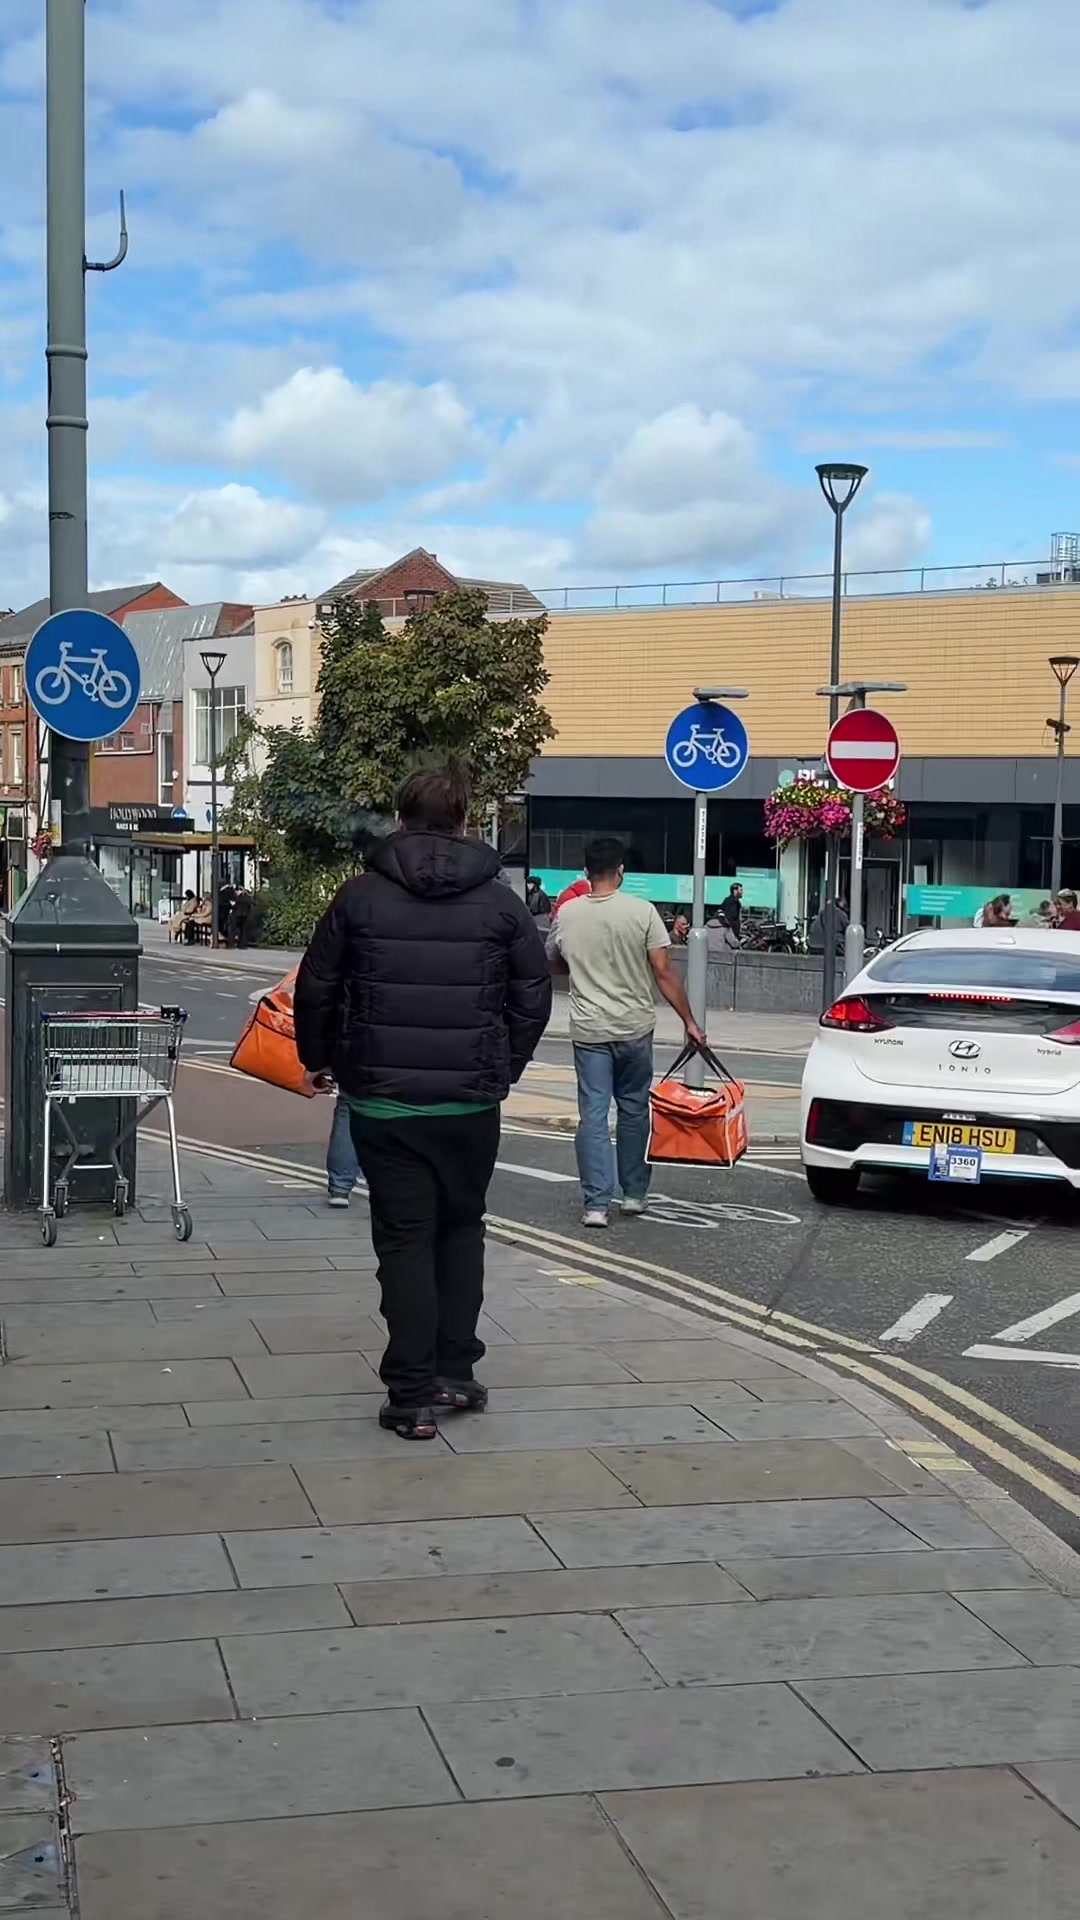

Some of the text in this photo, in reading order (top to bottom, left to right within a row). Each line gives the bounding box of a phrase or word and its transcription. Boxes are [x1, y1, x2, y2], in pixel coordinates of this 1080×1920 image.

[920, 1125, 1007, 1148] EN18 HSU
[950, 1157, 976, 1166] 3360
